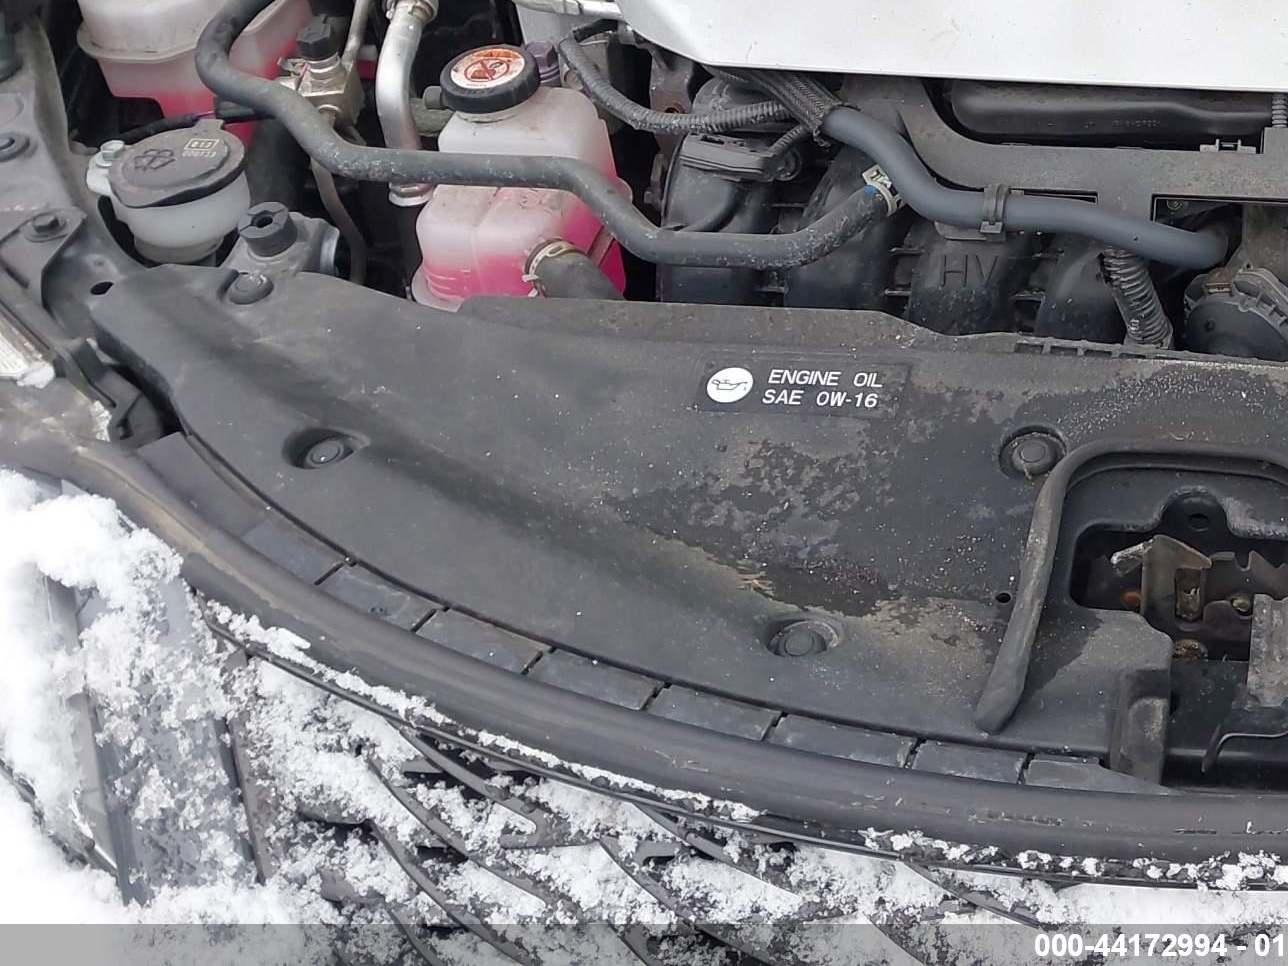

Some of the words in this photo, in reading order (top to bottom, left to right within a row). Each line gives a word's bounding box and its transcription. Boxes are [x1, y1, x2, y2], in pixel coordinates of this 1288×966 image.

[941, 254, 999, 287] HV
[768, 369, 842, 386] ENGINE
[853, 372, 883, 388] OIL
[762, 389, 804, 405] SAE
[816, 391, 878, 408] 0W-16
